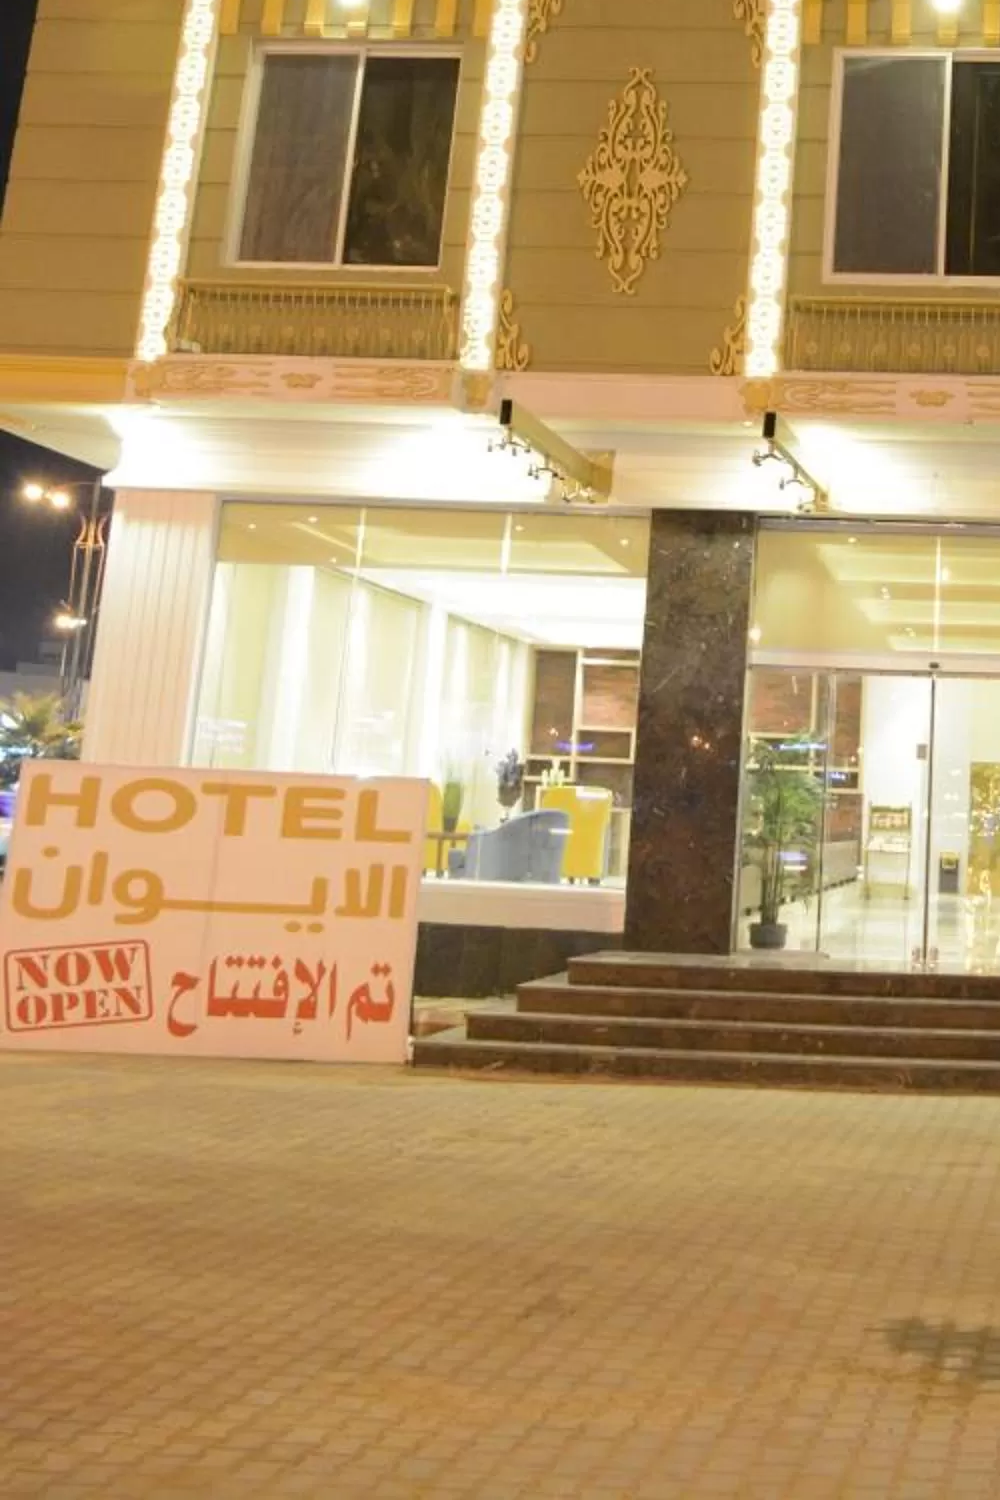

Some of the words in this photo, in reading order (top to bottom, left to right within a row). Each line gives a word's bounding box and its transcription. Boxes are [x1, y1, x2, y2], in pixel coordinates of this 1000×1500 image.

[25, 773, 412, 844] HOTEL
[14, 946, 138, 992] NOW
[15, 985, 144, 1026] OPEN
[346, 962, 396, 1042] تم
